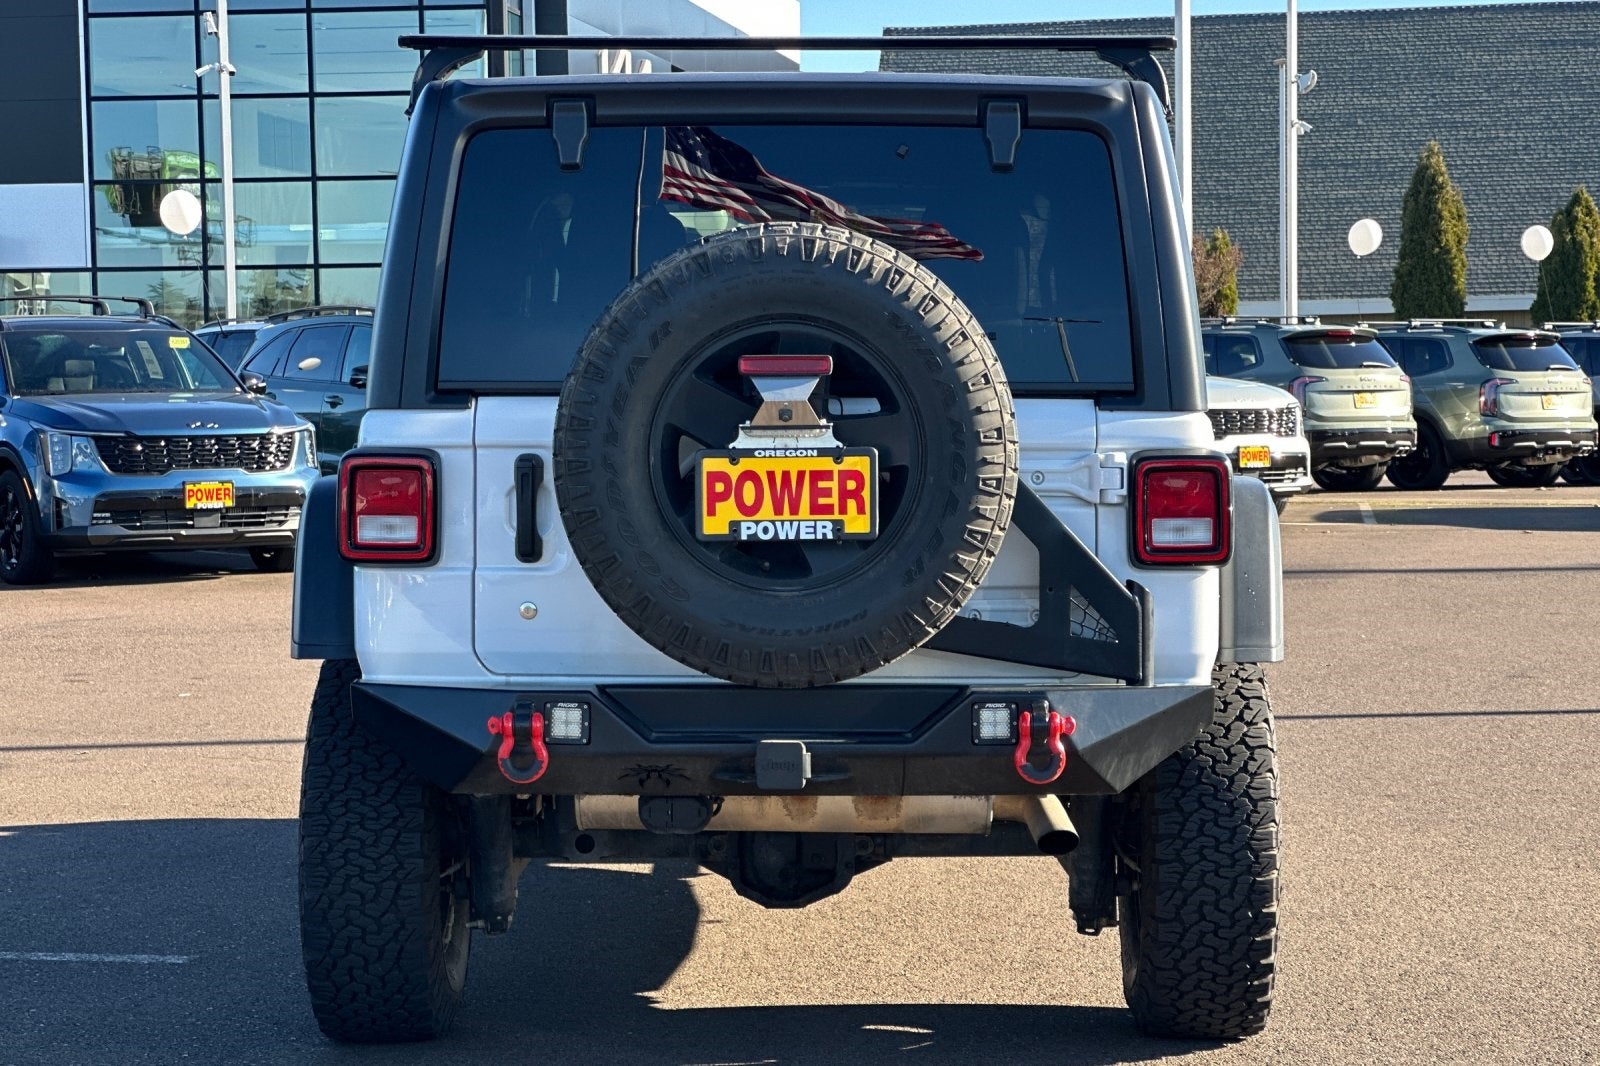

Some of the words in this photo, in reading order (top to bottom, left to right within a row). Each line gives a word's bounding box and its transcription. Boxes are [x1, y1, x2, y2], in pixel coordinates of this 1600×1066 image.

[601, 320, 690, 600] GOODYEAR
[754, 449, 818, 457] OREGON
[1241, 450, 1269, 462] POWER
[187, 487, 231, 502] POWER
[706, 469, 867, 518] POWER
[740, 520, 834, 541] POWER
